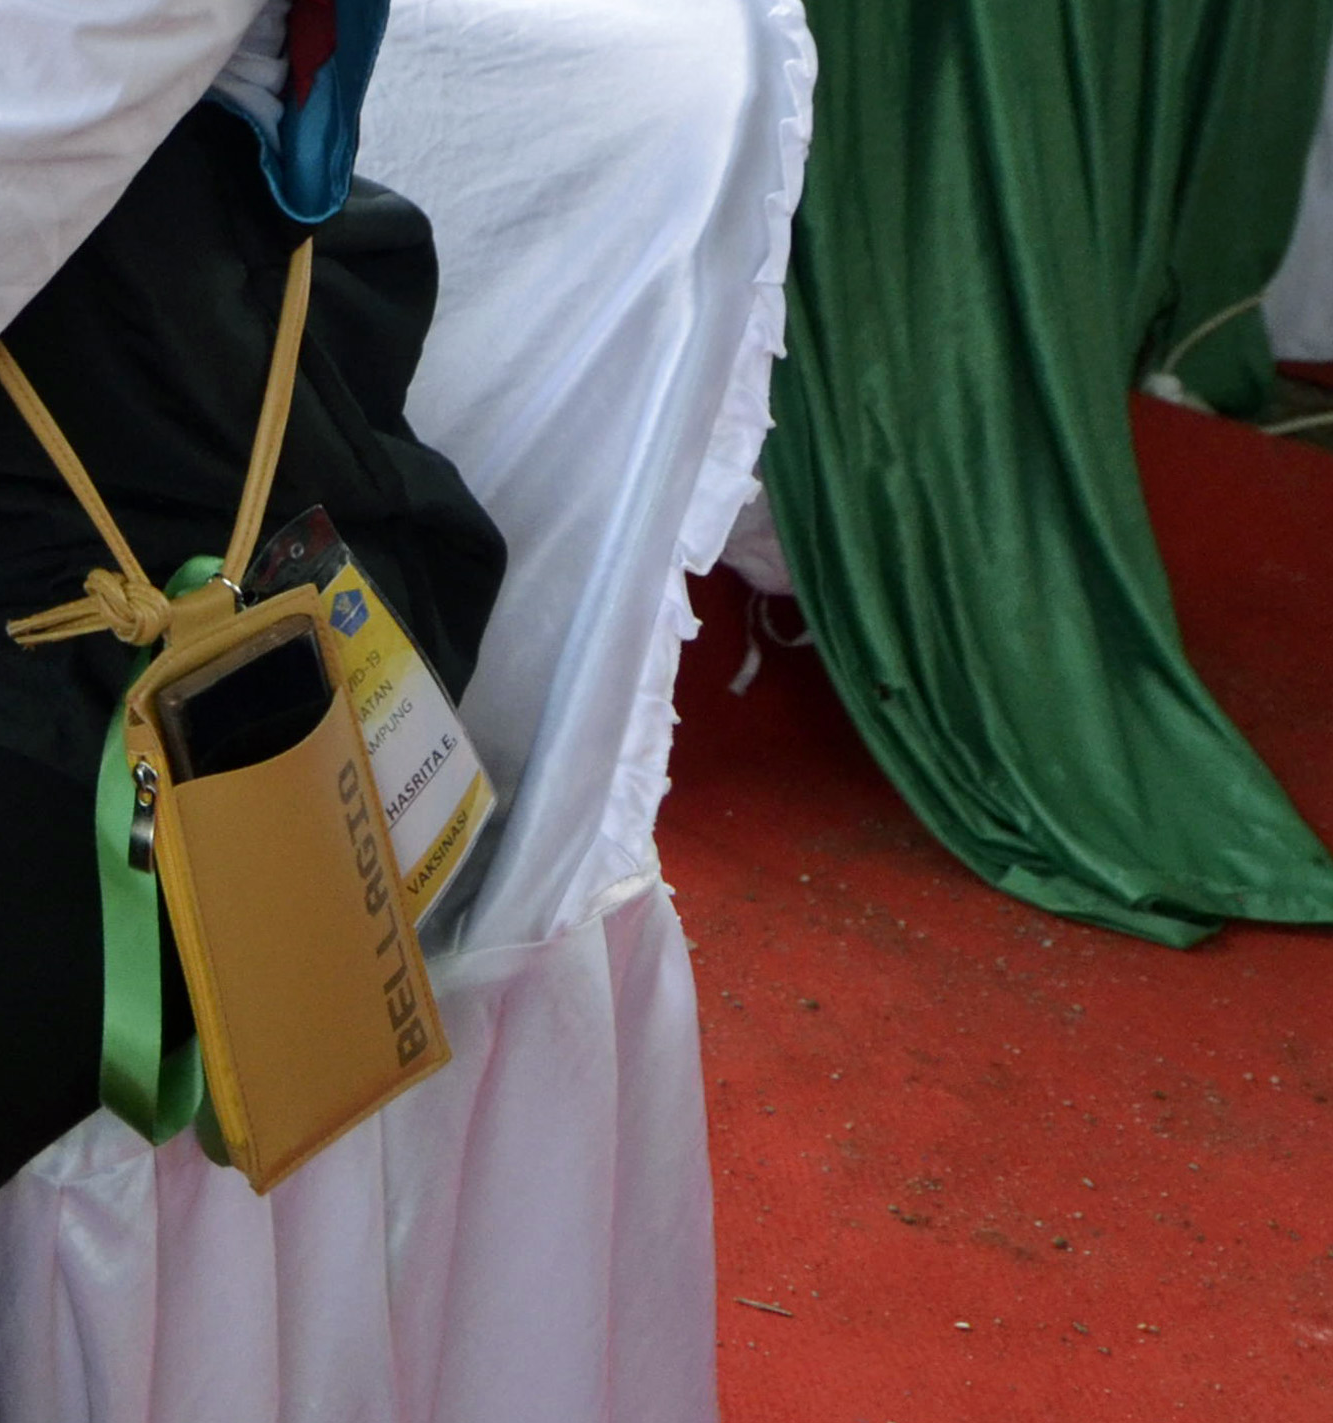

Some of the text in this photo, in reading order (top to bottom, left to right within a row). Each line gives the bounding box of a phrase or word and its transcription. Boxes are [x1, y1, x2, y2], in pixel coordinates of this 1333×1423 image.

[386, 748, 445, 822] HASRITA
[406, 809, 469, 896] VAKSINASI
[338, 758, 429, 1069] BELLAGIO
